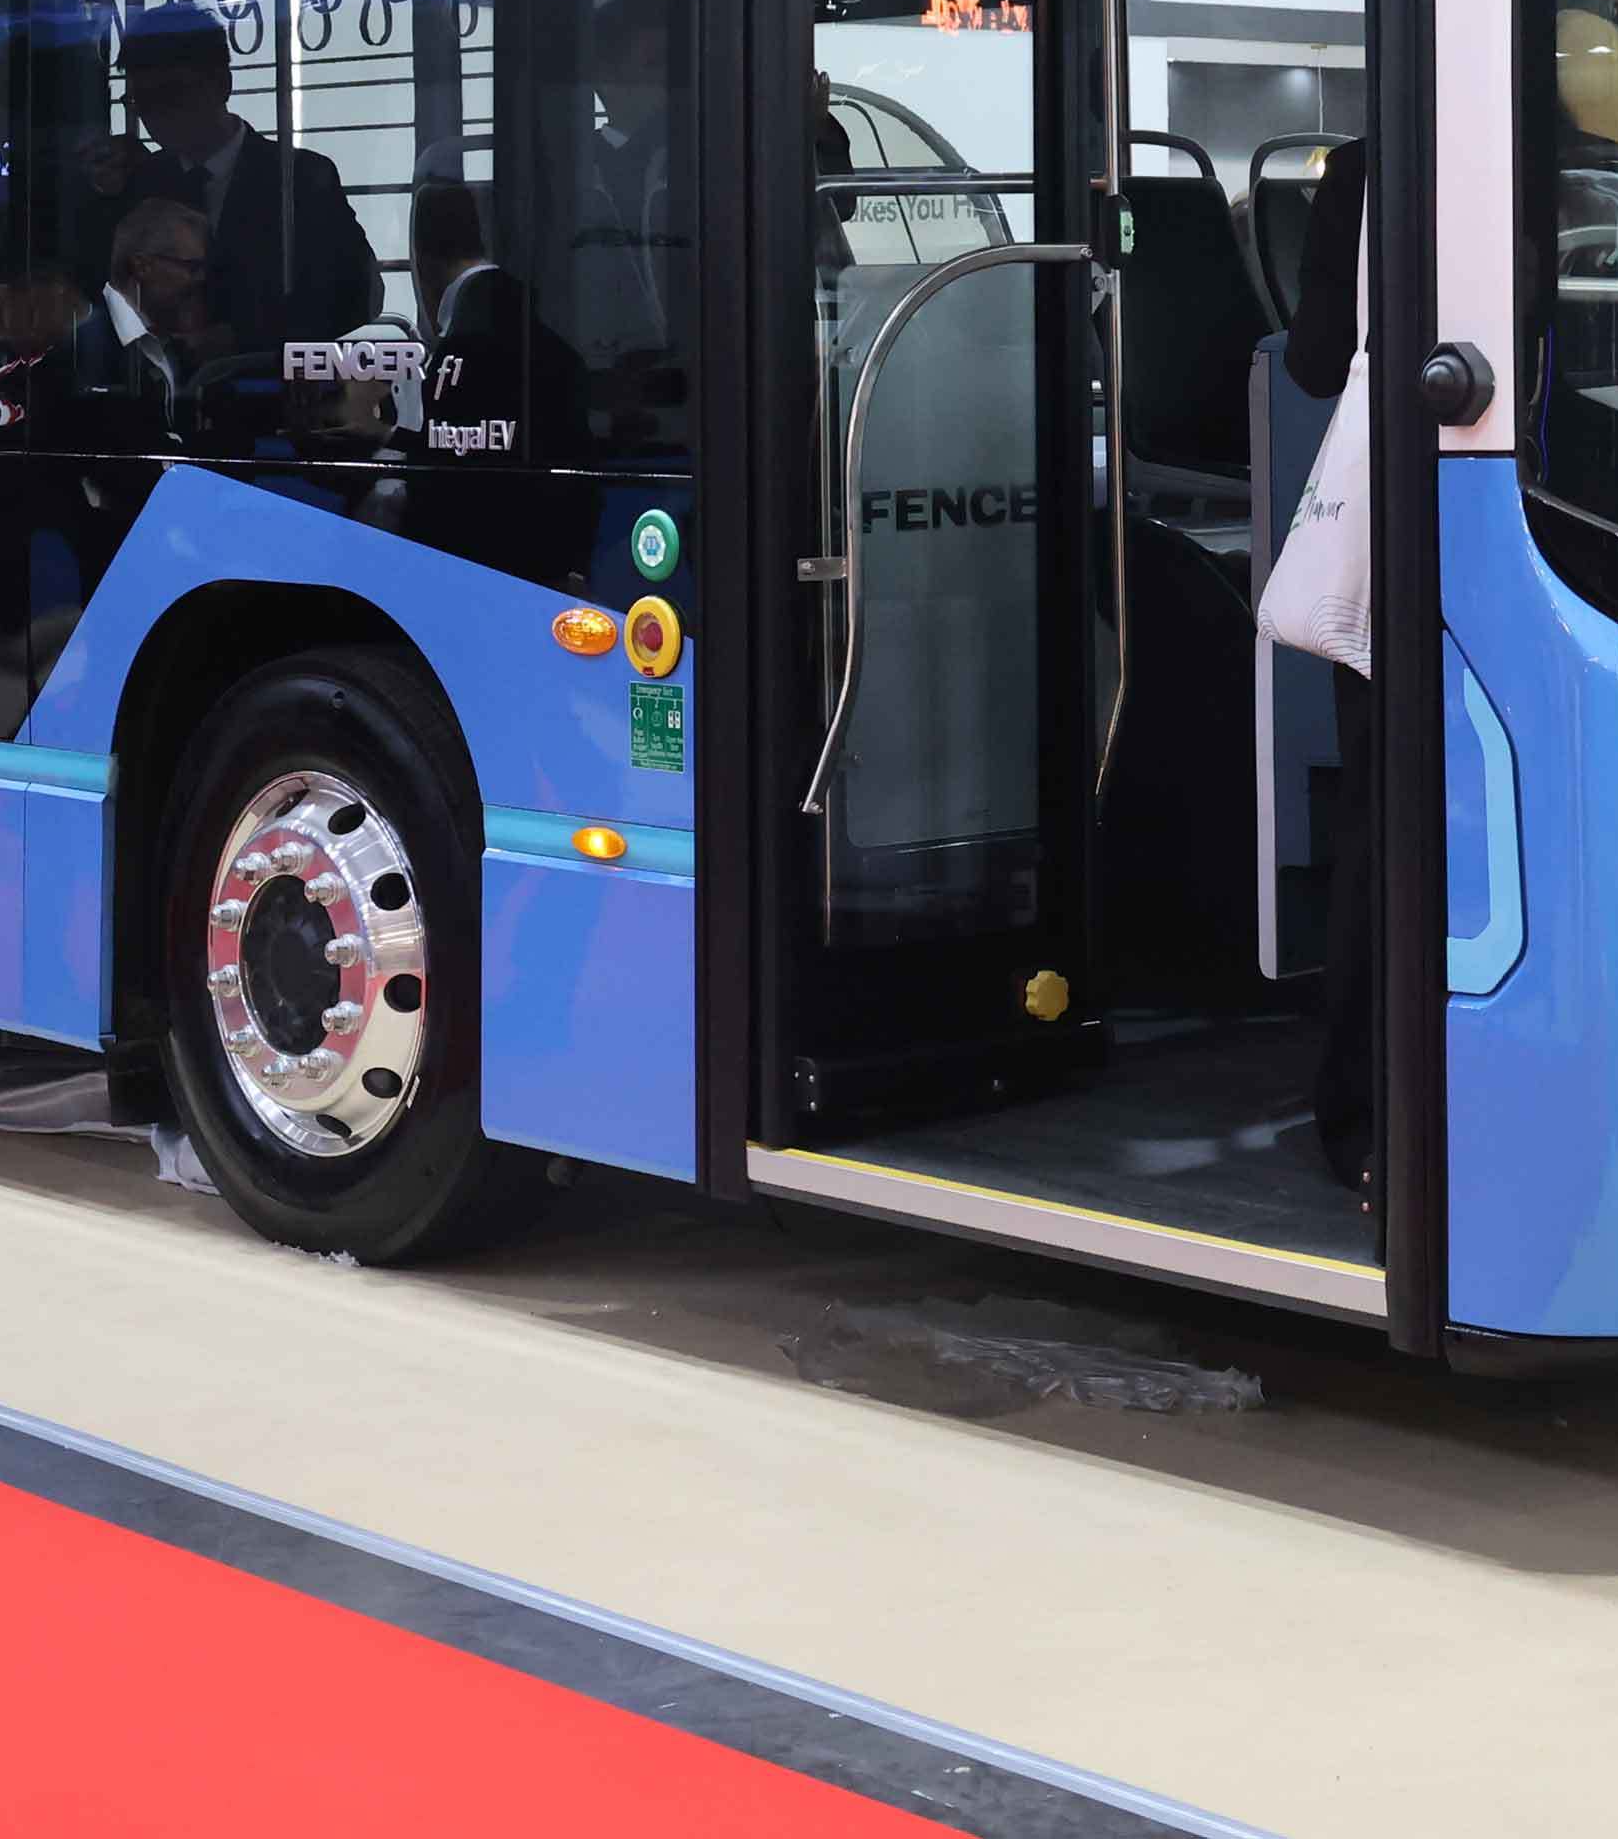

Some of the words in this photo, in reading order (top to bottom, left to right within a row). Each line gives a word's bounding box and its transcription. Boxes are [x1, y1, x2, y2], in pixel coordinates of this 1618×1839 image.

[906, 194, 944, 221] You
[284, 341, 426, 381] FENCER
[428, 419, 486, 456] Integral
[488, 420, 517, 451] EV
